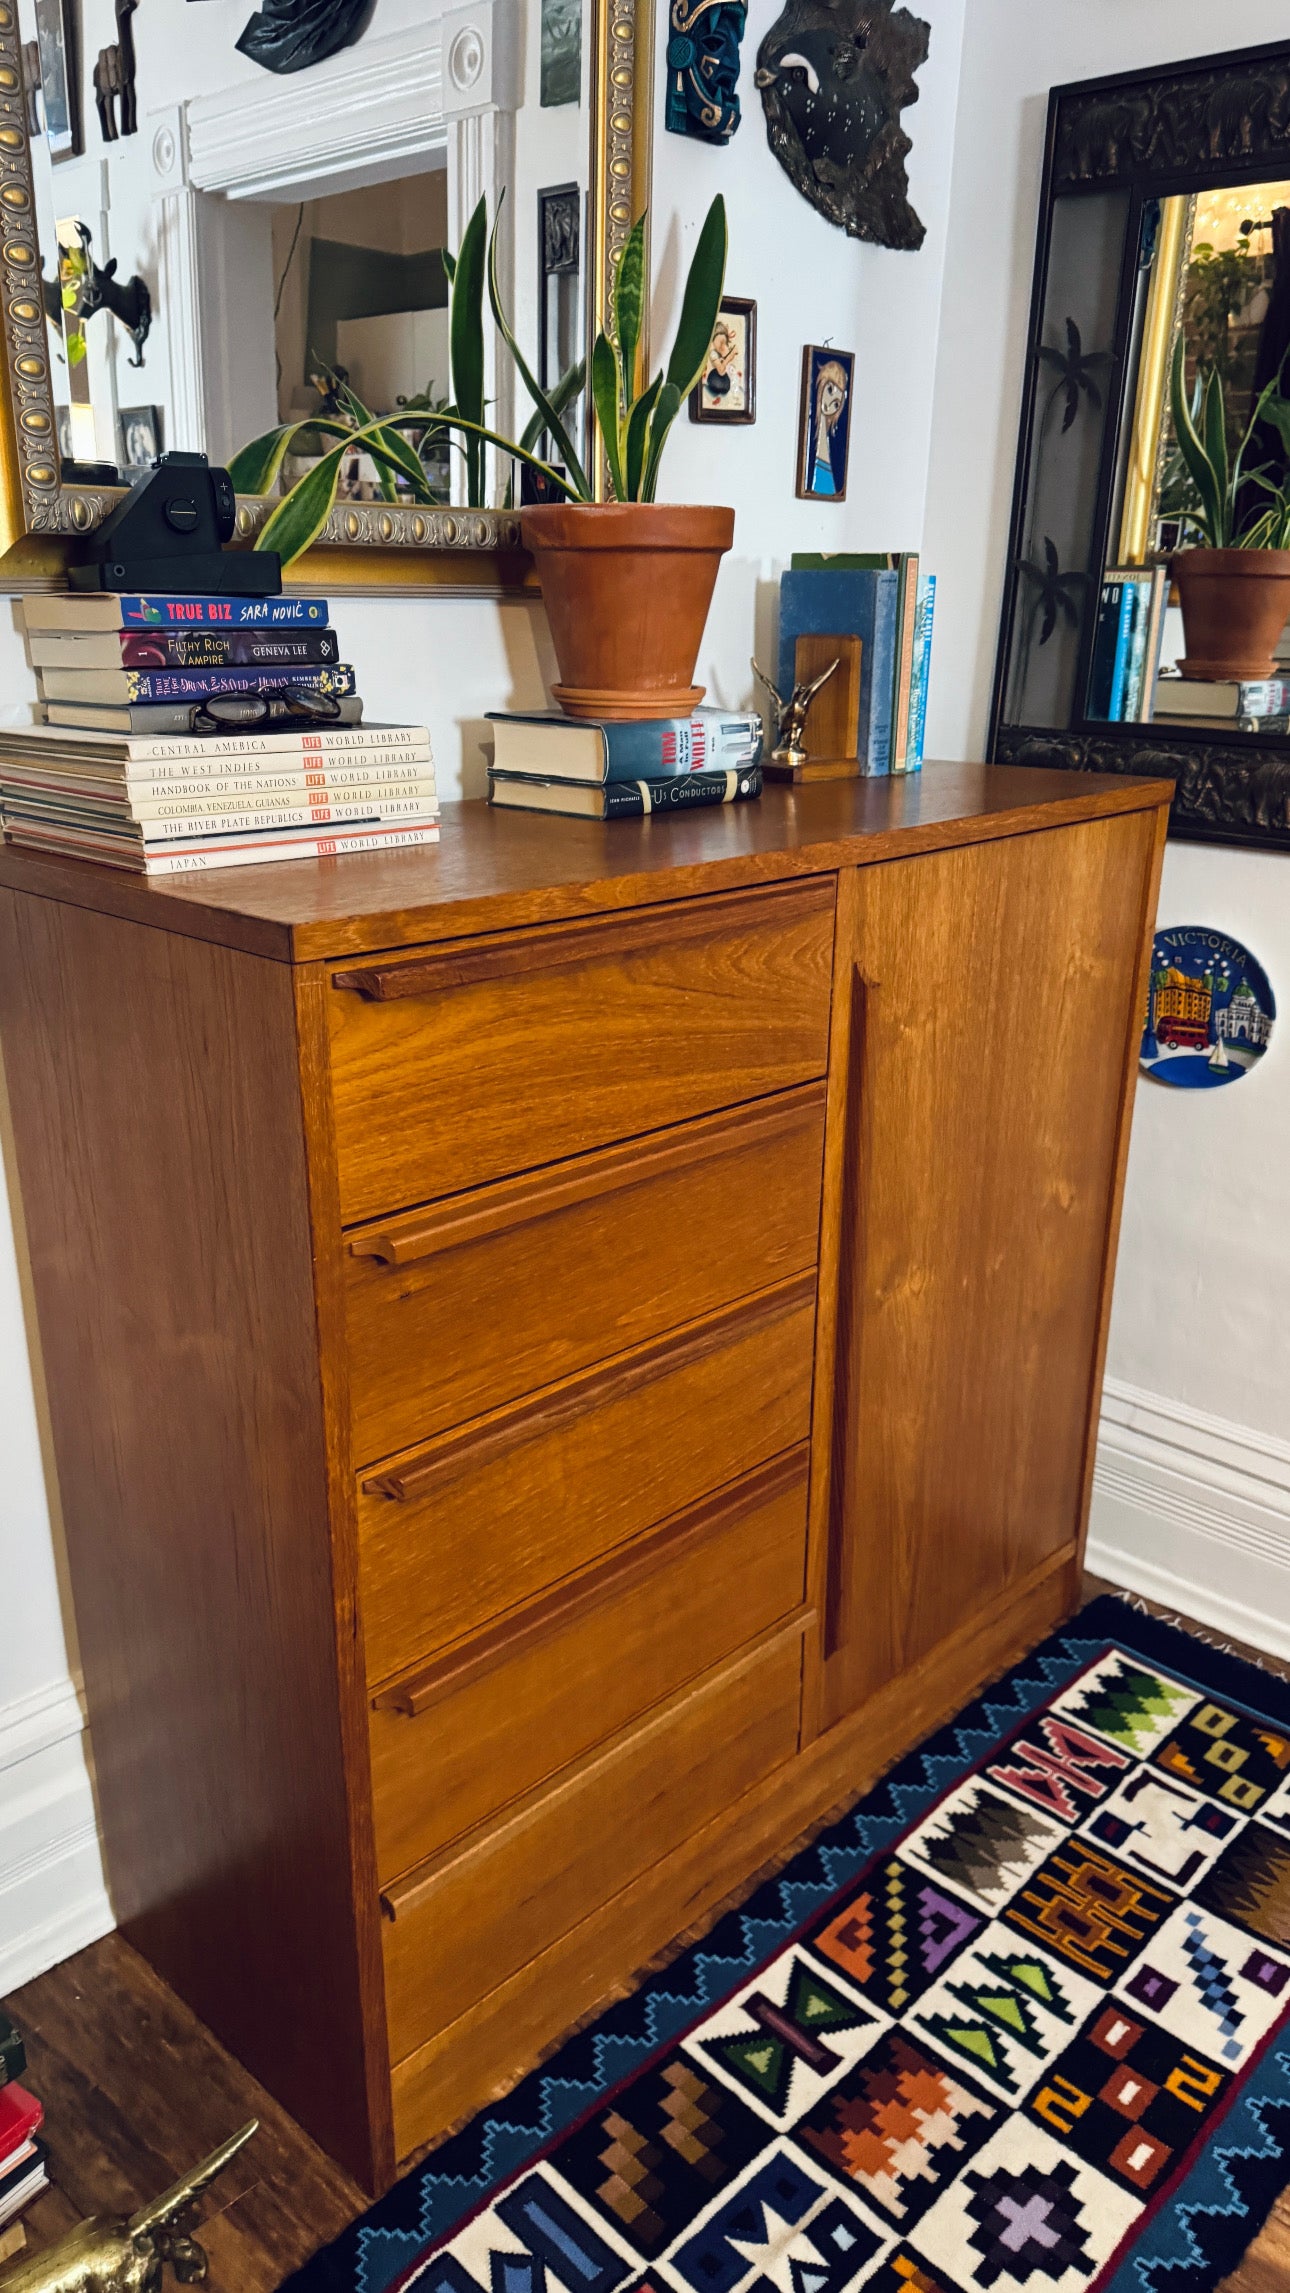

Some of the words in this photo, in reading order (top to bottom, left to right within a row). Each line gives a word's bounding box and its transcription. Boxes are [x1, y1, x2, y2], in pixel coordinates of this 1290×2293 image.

[166, 603, 203, 620] TRUE
[208, 603, 232, 620] BIZ
[239, 603, 268, 622] SARA
[272, 601, 304, 621] NOVIĆ
[167, 639, 201, 652] FILTHY
[204, 638, 230, 651] RICH
[253, 646, 290, 656] GENEVA
[293, 645, 307, 655] LEE
[177, 653, 224, 666] VAMPIRE
[152, 743, 206, 756] CENTRAL
[215, 740, 266, 752] AMERICA
[302, 736, 321, 749] LIFE
[325, 735, 364, 746] WORLD
[370, 732, 412, 744] LIBRARY
[661, 731, 676, 765] TOM
[690, 720, 705, 772] WOLFE
[303, 756, 323, 769] LIFE
[328, 755, 367, 767] WORLD
[373, 752, 416, 763] LIBRARY
[150, 767, 174, 778] THE
[181, 764, 213, 776] WEST
[220, 762, 260, 773] INDIES
[305, 774, 326, 786] LIFE
[330, 772, 369, 783] WORLD
[376, 768, 418, 780] LIBRARY
[152, 783, 211, 796] HANDBOOK
[216, 782, 229, 792] OF
[233, 781, 253, 790] THE
[256, 777, 297, 789] NATIONS
[309, 792, 328, 805] LIFE
[333, 790, 372, 801] WORLD
[378, 786, 419, 798] LIBRARY
[670, 786, 725, 802] CONDUCTORS
[158, 803, 203, 815] COLOMBIA
[206, 800, 252, 813] VENEZUELA
[255, 797, 290, 808] GUIANAS
[312, 808, 331, 821] LIFE
[335, 806, 373, 817] WORLD
[379, 802, 420, 814] LIBRARY
[163, 823, 183, 834] THE
[188, 820, 217, 831] RIVER
[221, 817, 251, 828] PLATE
[254, 812, 303, 826] REPUBLICS
[317, 841, 337, 854] LIFE
[340, 838, 378, 849] WORLD
[384, 832, 425, 845] LIBRARY
[170, 856, 207, 871] JAPAN
[1164, 932, 1247, 968] VICTORIA
